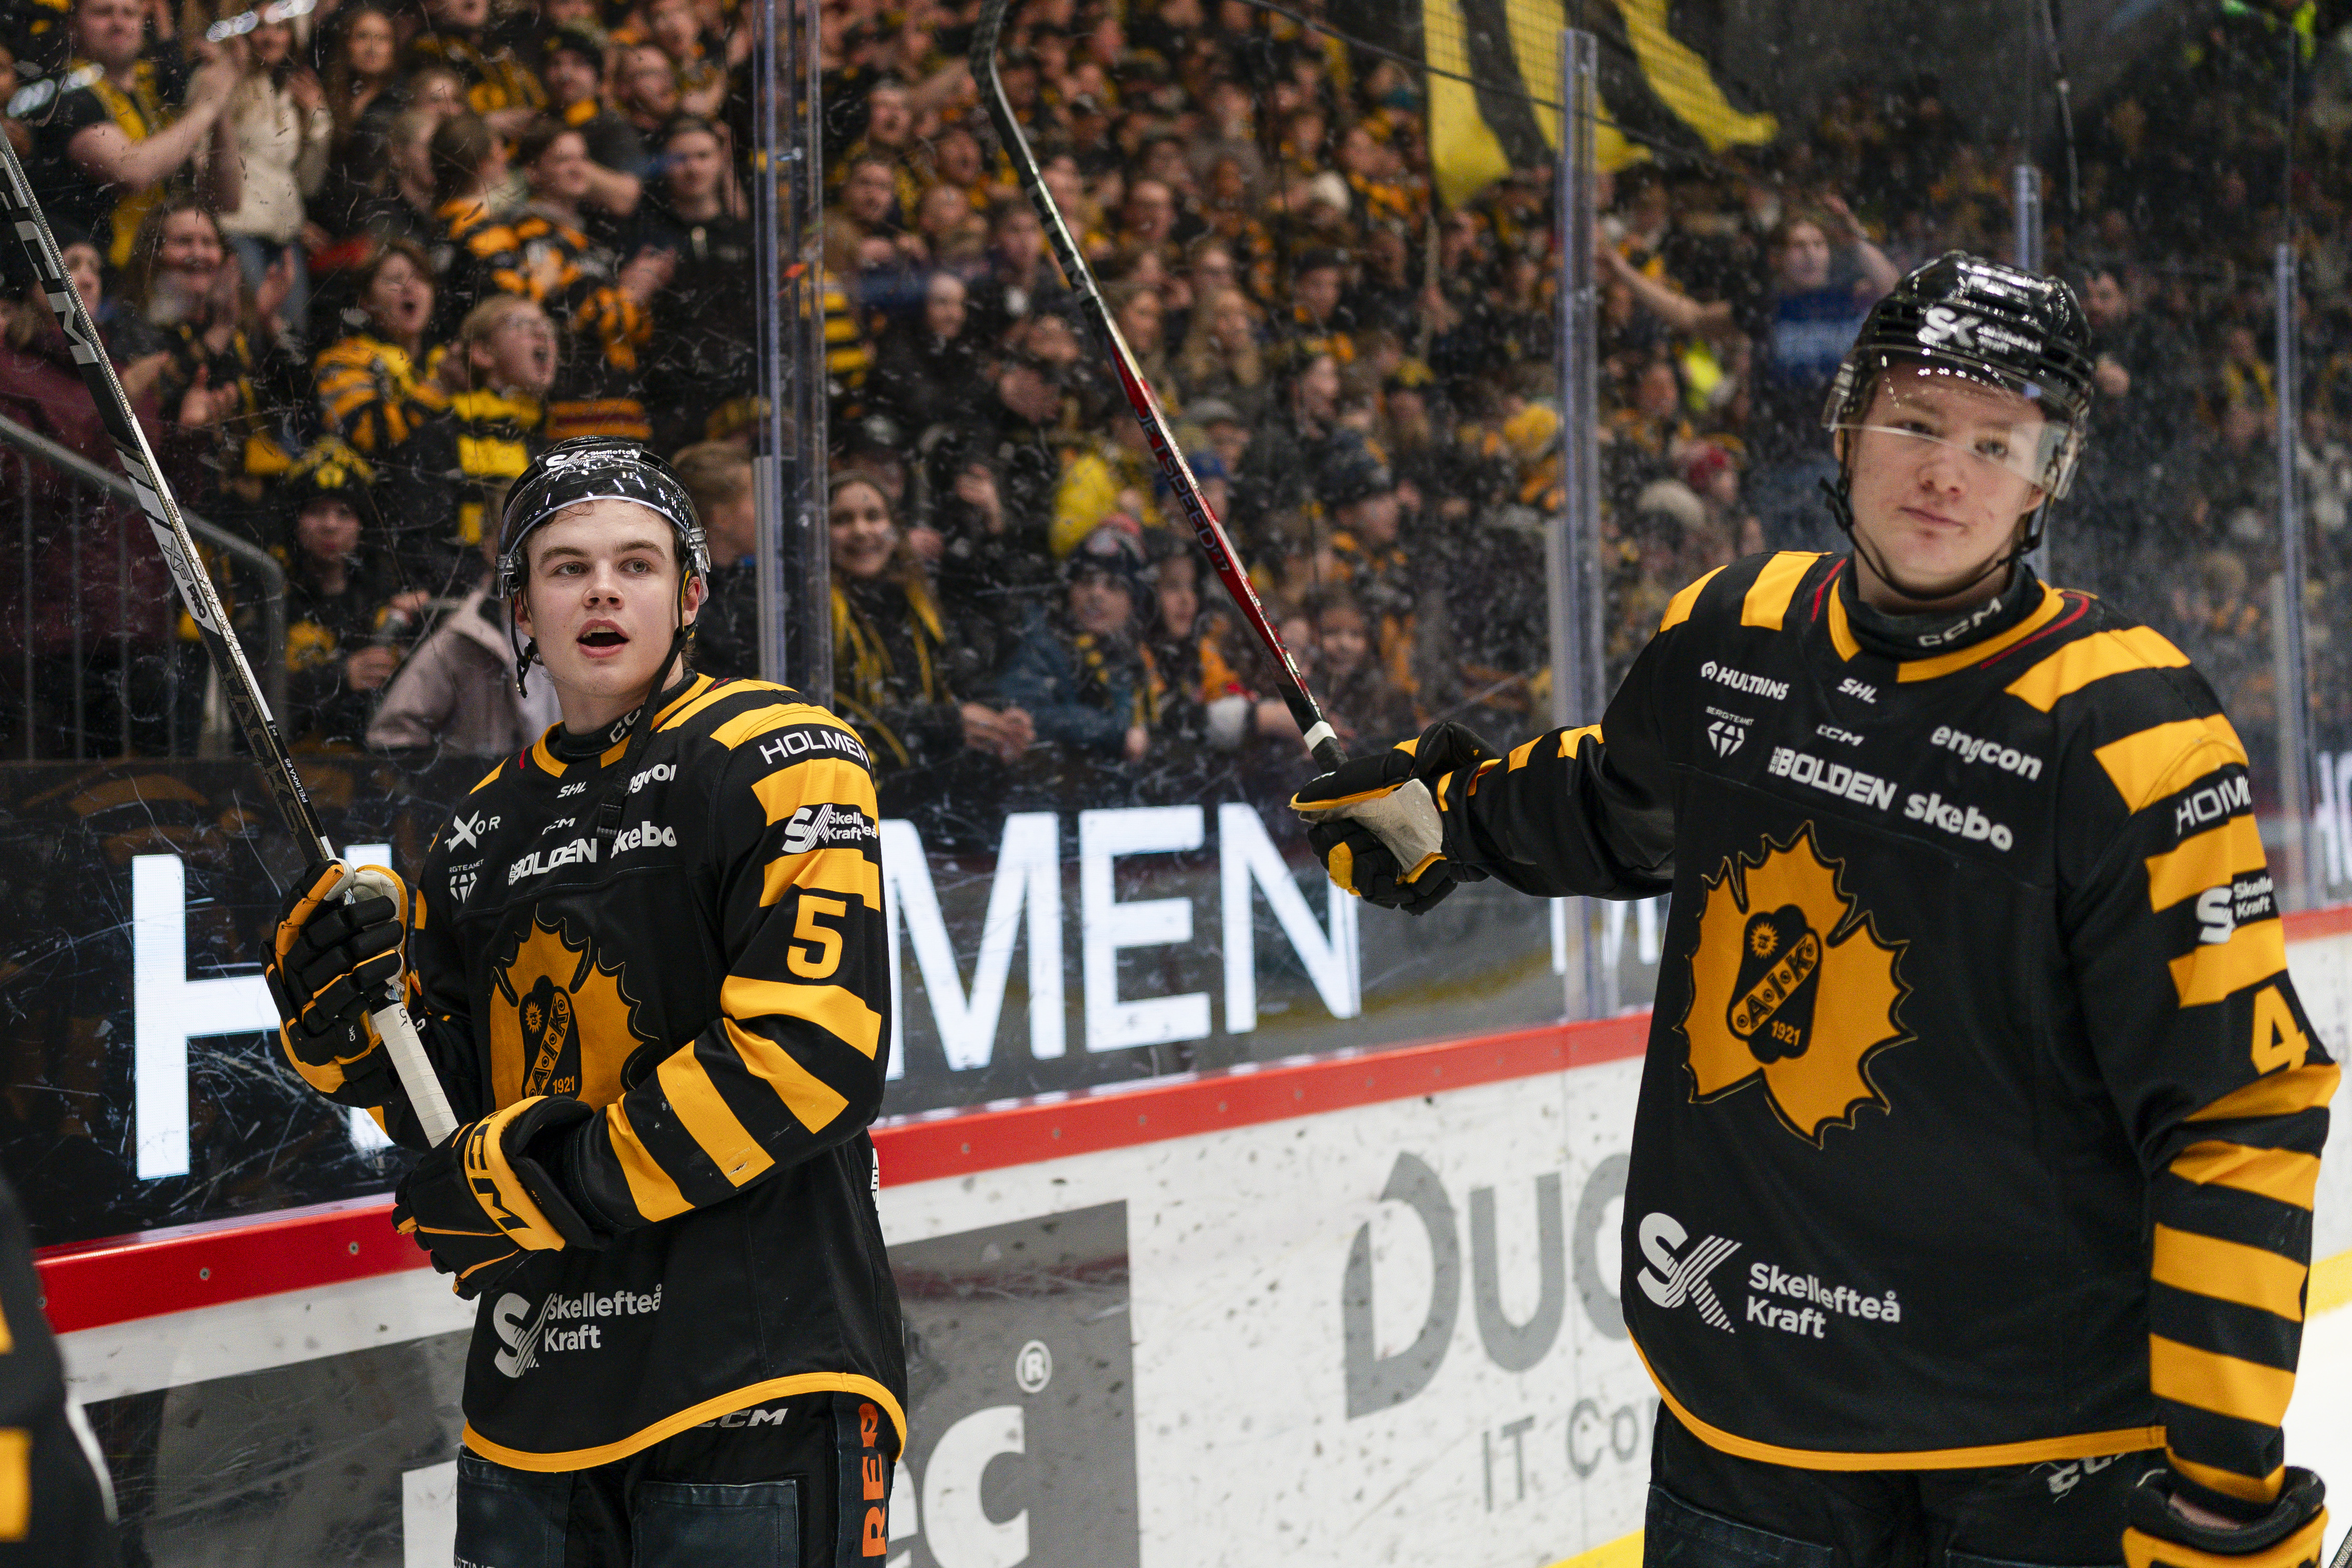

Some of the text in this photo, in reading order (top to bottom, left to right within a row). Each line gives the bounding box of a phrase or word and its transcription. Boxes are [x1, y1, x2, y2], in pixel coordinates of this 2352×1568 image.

[1134, 407, 1216, 549] JETSPEED
[186, 583, 207, 620] PRO
[1918, 597, 2002, 647] CCM
[1837, 678, 1878, 704] SHL
[759, 730, 871, 770] HOLMEN
[1930, 725, 2043, 781] engcon
[284, 758, 309, 803] PELIKKA #5
[557, 781, 587, 799] SHL
[828, 827, 862, 841] Kraft
[1904, 792, 2013, 852] skebo
[787, 894, 846, 980] 5
[1771, 1020, 1801, 1047] 1921
[2251, 985, 2309, 1075] 4
[552, 1075, 576, 1095] 1921
[548, 1283, 662, 1320] Skellefteå
[1749, 1262, 1901, 1323] Skellefteå
[545, 1324, 601, 1353] Kraft
[1746, 1295, 1827, 1339] Kraft
[1481, 1416, 1536, 1513] IT
